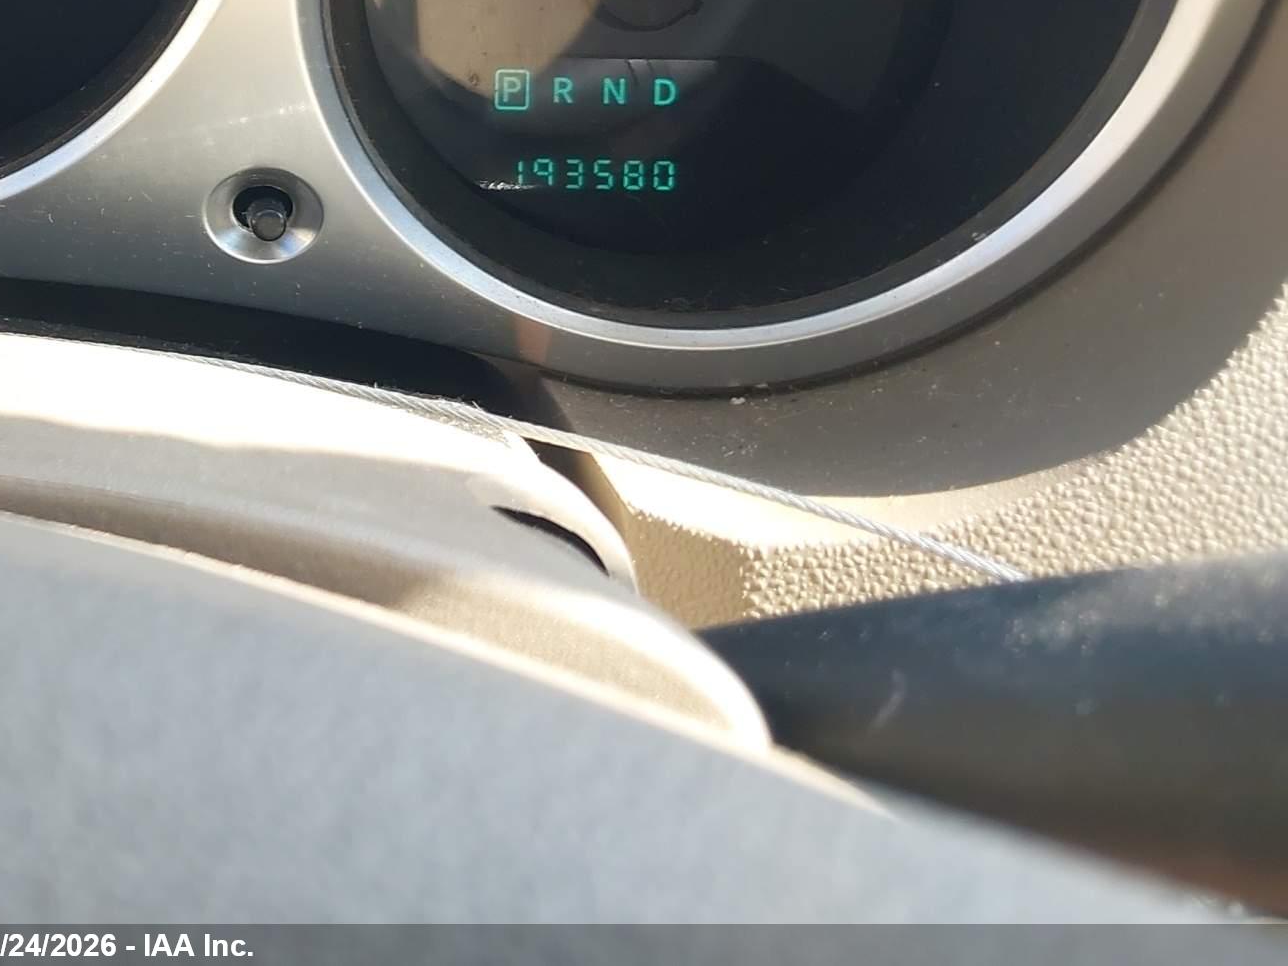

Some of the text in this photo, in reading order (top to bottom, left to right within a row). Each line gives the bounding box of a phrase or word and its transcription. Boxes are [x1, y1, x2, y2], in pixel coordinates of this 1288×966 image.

[502, 76, 676, 105] P R N D
[516, 158, 676, 191] 193580
